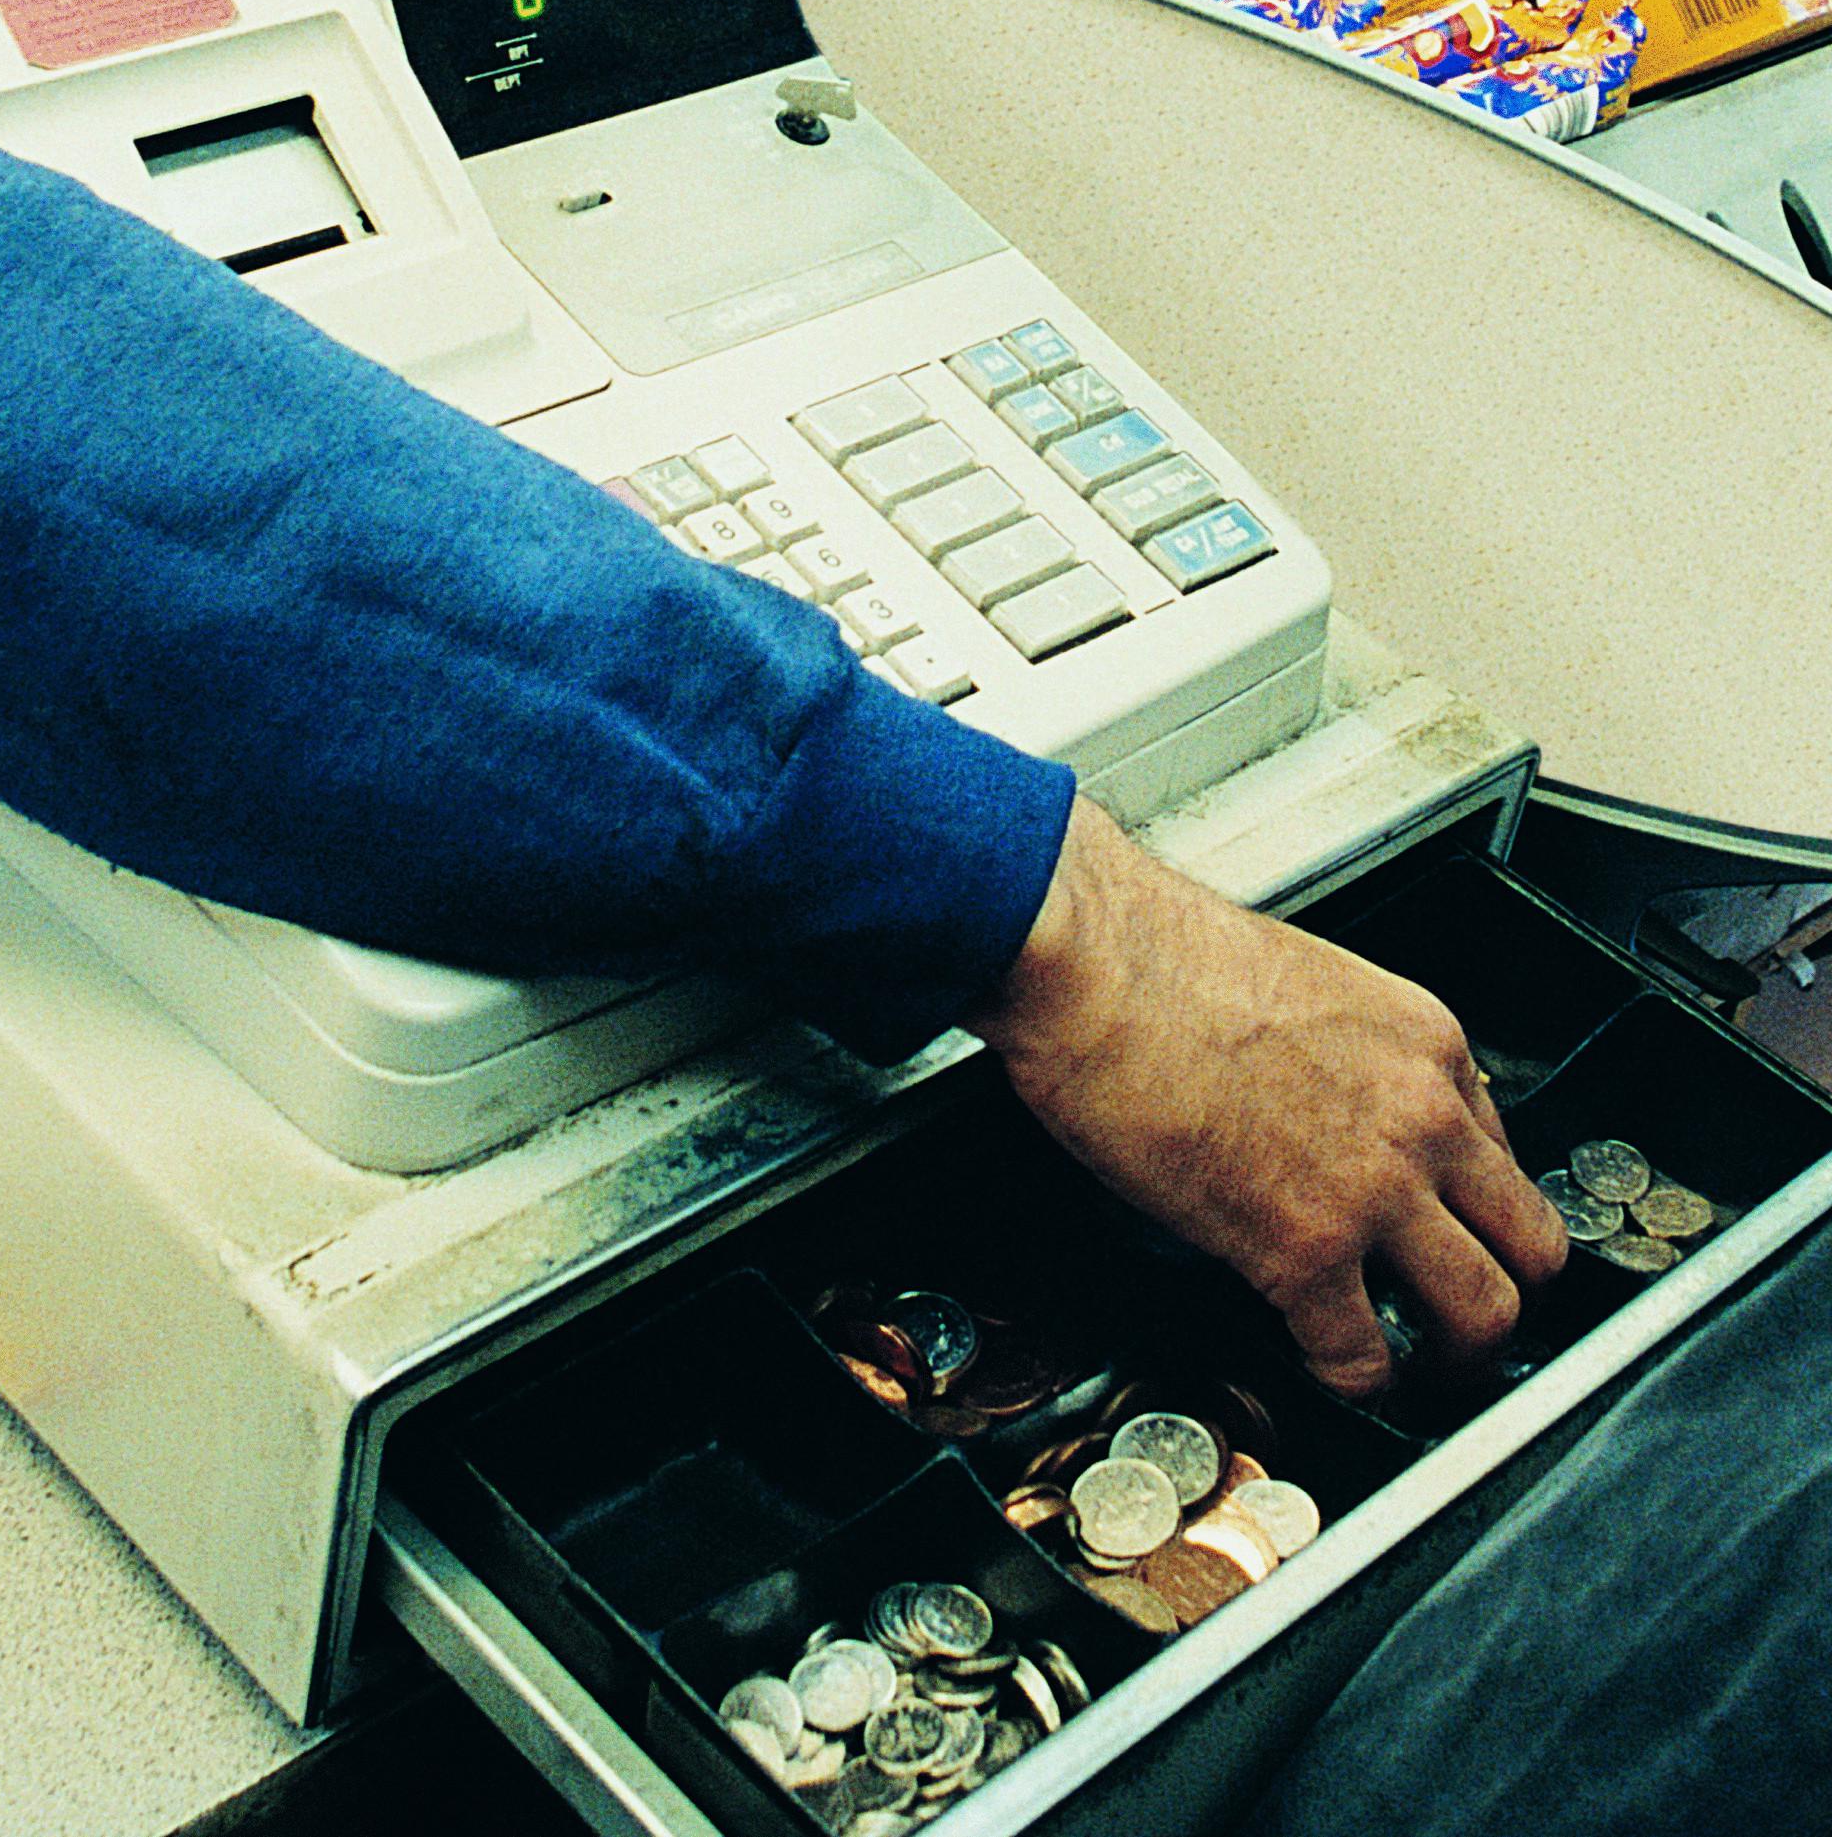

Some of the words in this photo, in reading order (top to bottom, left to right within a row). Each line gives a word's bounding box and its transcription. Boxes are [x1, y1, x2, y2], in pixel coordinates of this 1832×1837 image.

[494, 73, 521, 92] DEPT
[770, 499, 792, 519] 9
[712, 520, 736, 540] 8
[819, 548, 841, 568] 6
[870, 599, 893, 619] 3
